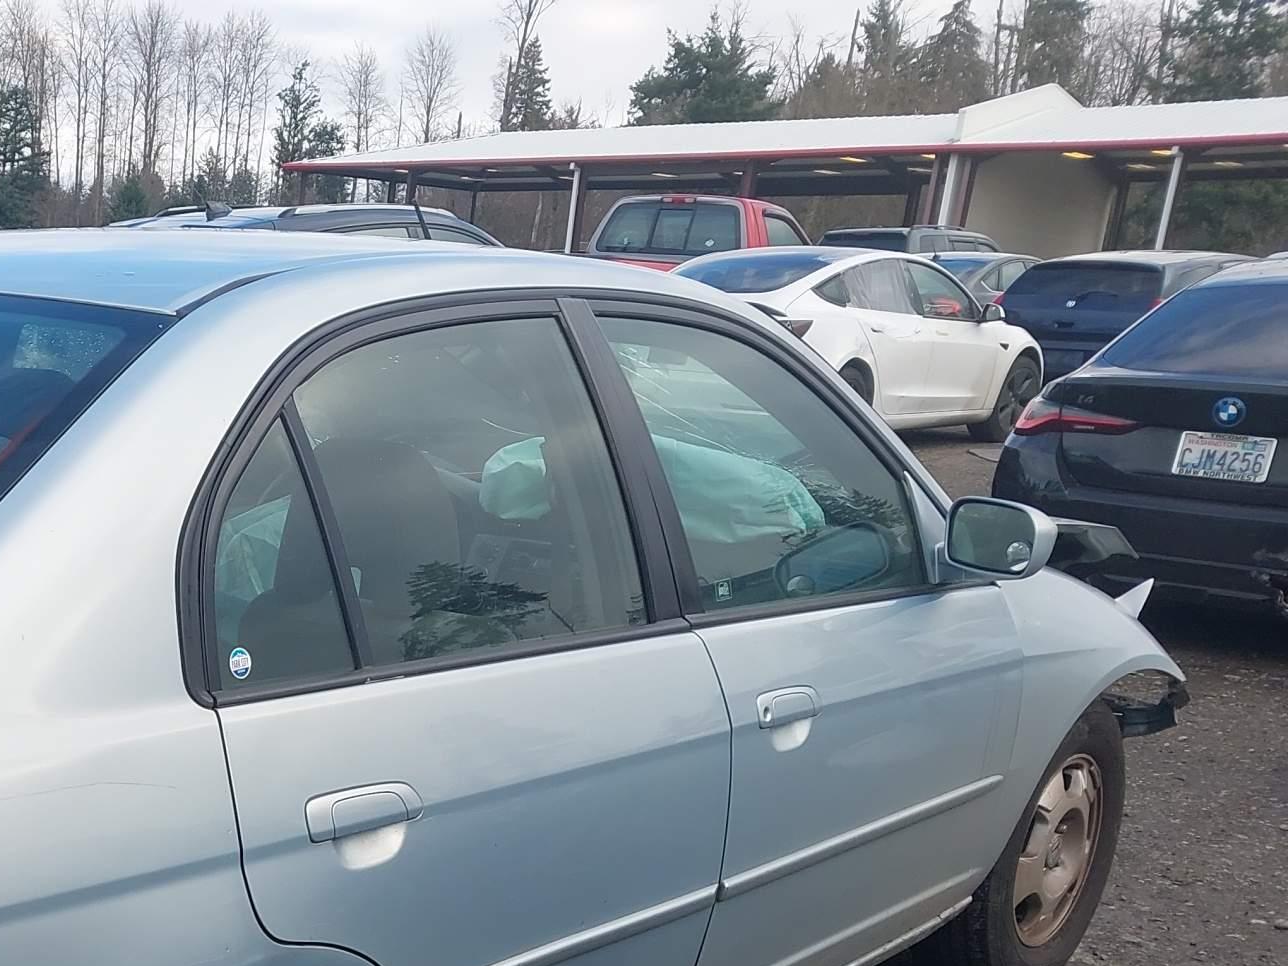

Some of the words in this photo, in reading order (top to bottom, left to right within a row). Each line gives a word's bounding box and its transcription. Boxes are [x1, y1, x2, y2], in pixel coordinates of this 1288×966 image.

[1187, 438, 1239, 447] WASHINGTON
[1180, 447, 1265, 474] CJM4256
[1178, 467, 1201, 476] BMW
[1203, 470, 1258, 481] NORTHWEST
